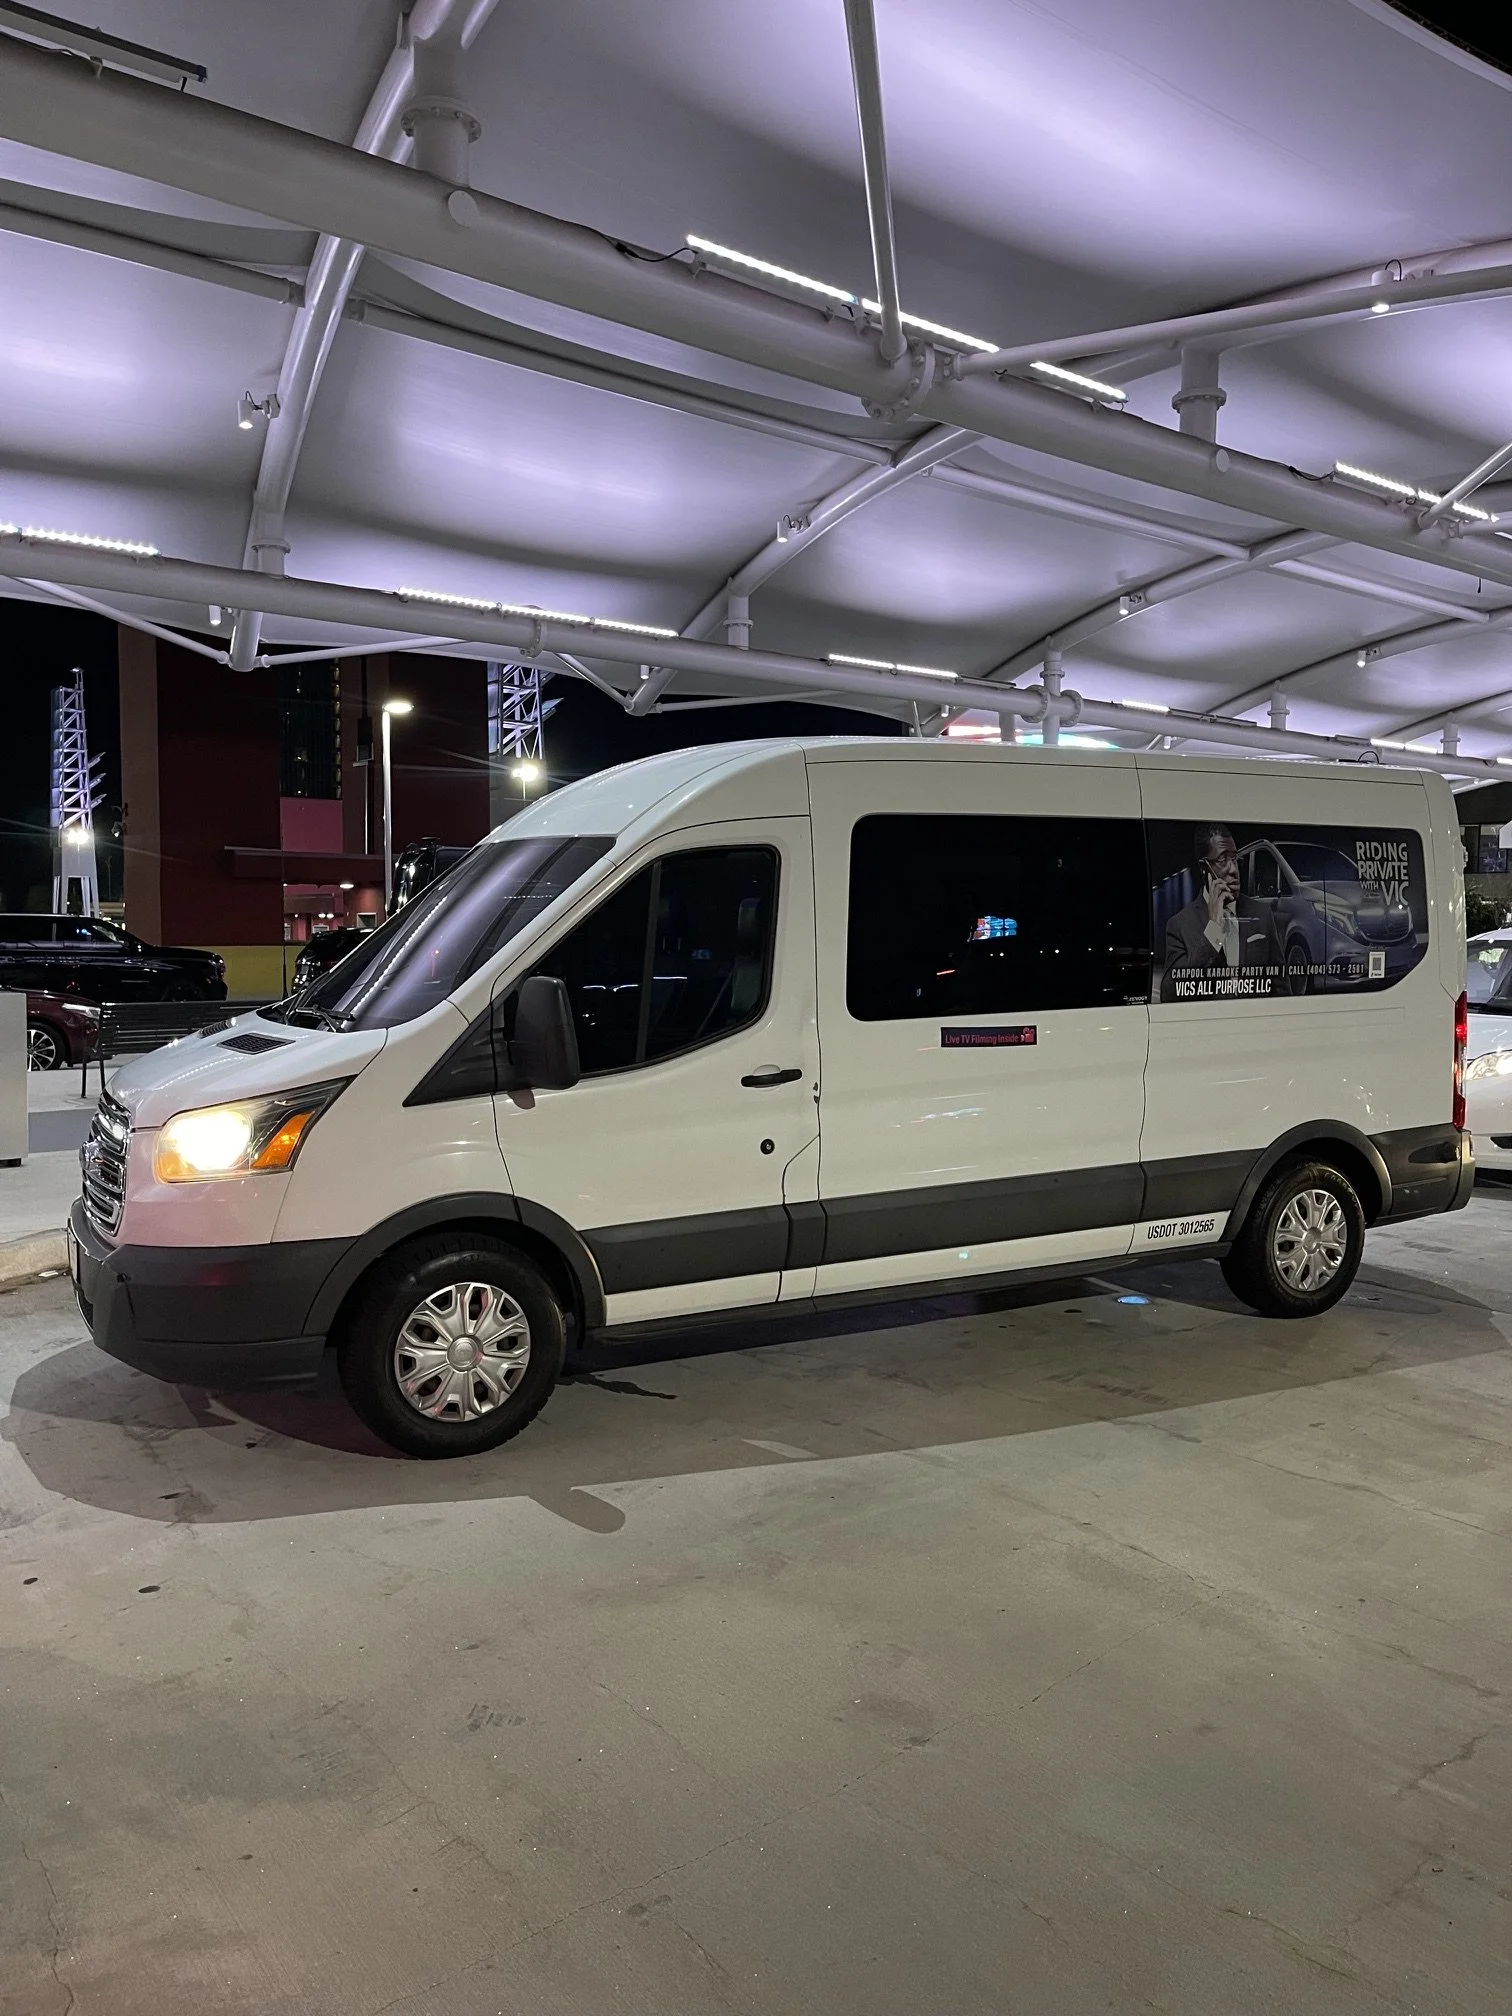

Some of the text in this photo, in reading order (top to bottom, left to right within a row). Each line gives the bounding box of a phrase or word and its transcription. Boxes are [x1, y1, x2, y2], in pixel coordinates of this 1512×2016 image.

[1356, 841, 1408, 861] RIDING
[1357, 860, 1409, 880] PRIVATE
[1359, 880, 1379, 891] WITH
[1380, 880, 1409, 906] VIC
[1171, 968, 1205, 979] CARPOOL
[1206, 967, 1239, 978] KARAOKE
[1241, 966, 1264, 977] PARTY
[1266, 965, 1279, 976] VAN
[1288, 965, 1305, 975] CALL
[1306, 964, 1326, 976] (404)
[1327, 964, 1341, 974] 573
[1176, 978, 1272, 997] VICS ALL PURPOSE LLC
[945, 1033, 1019, 1045] Live TV Filming Inside
[1147, 1219, 1215, 1240] USDOT 3012565
